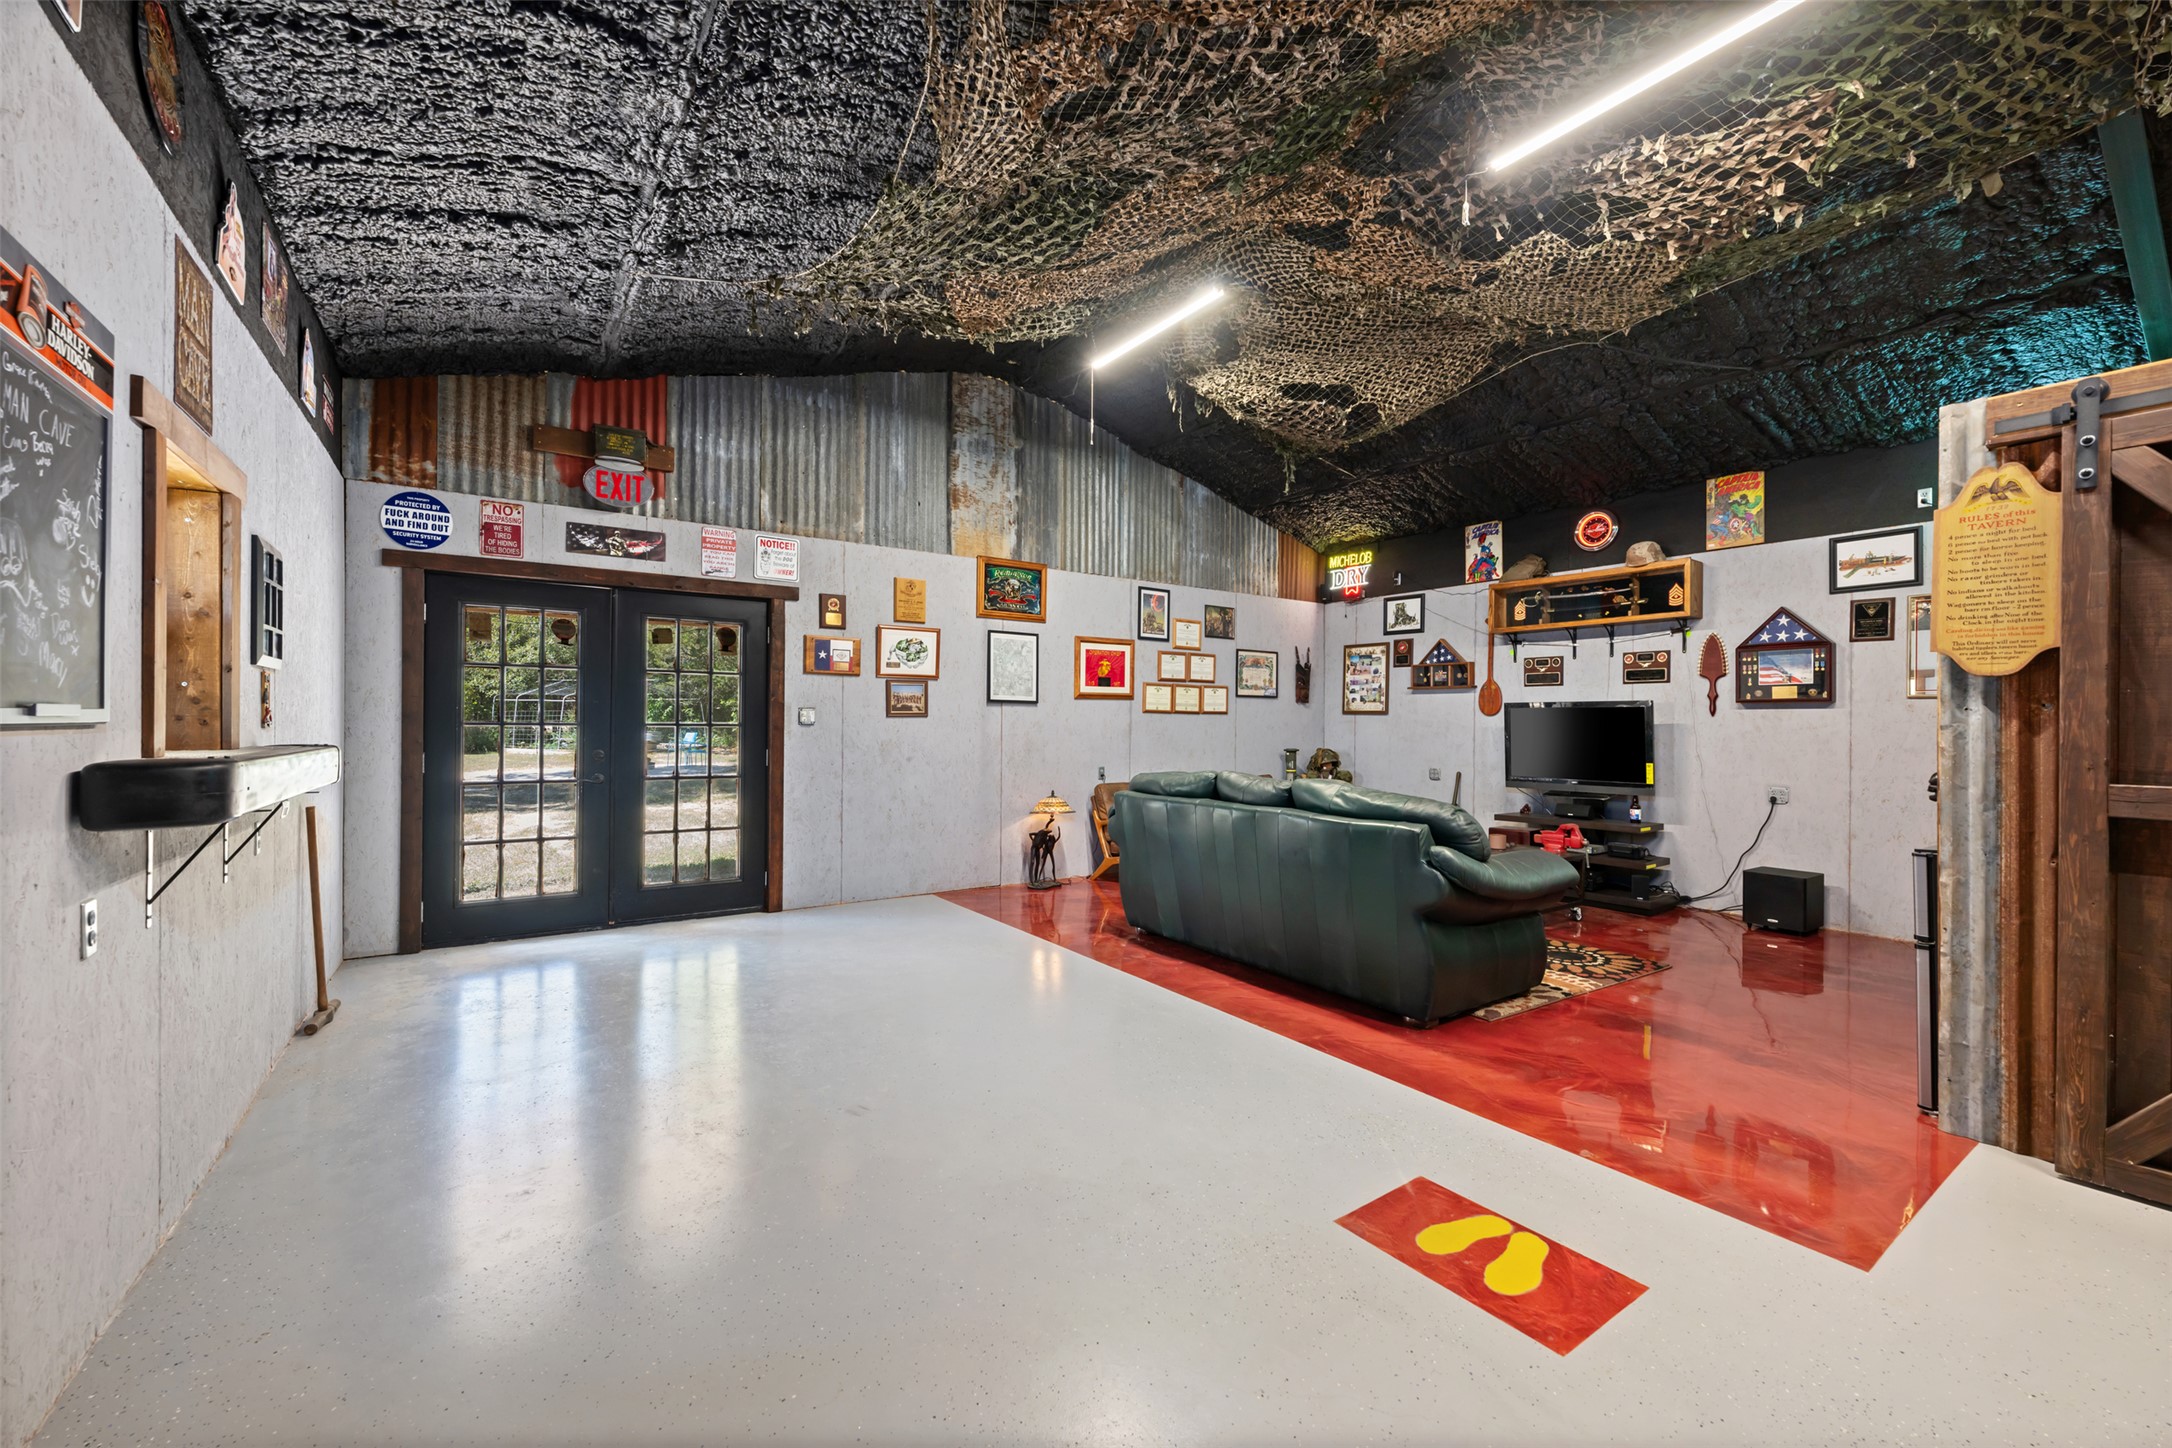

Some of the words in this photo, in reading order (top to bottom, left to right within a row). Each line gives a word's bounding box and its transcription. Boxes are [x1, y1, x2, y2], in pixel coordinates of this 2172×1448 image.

[179, 257, 211, 350] MAN
[51, 313, 93, 360] HARLEY-
[47, 328, 95, 381] DAVIDSON
[179, 326, 211, 413] CAVE
[3, 380, 29, 424] MAN
[39, 409, 75, 447] CAVE
[595, 469, 645, 503] EXIT
[395, 500, 431, 509] PROTECTED
[492, 504, 513, 516] NO
[385, 508, 409, 518] FUCK
[412, 511, 450, 523] AROUND
[483, 514, 522, 524] TRESPASSING
[1959, 512, 2000, 524] RULES
[2015, 508, 2036, 516] this
[385, 517, 404, 527] AND
[407, 520, 428, 530] FIND
[431, 523, 450, 533] OUT
[1967, 517, 2027, 530] TAVERN
[393, 530, 419, 538] SECURITY
[494, 532, 512, 540] TIRED
[703, 529, 735, 539] WARNING
[1985, 529, 2007, 537] night
[485, 545, 497, 553] THE
[497, 547, 520, 555] BODIES
[702, 543, 736, 551] PROPERTY
[760, 539, 796, 551] NOTICE!!
[1329, 551, 1372, 568] MICHELOB
[1329, 564, 1371, 590] DRY
[1984, 572, 2018, 580] grinders
[1996, 584, 2040, 592] walkabouts
[1965, 592, 1992, 600] allowed
[1947, 601, 1987, 609] Waggoners
